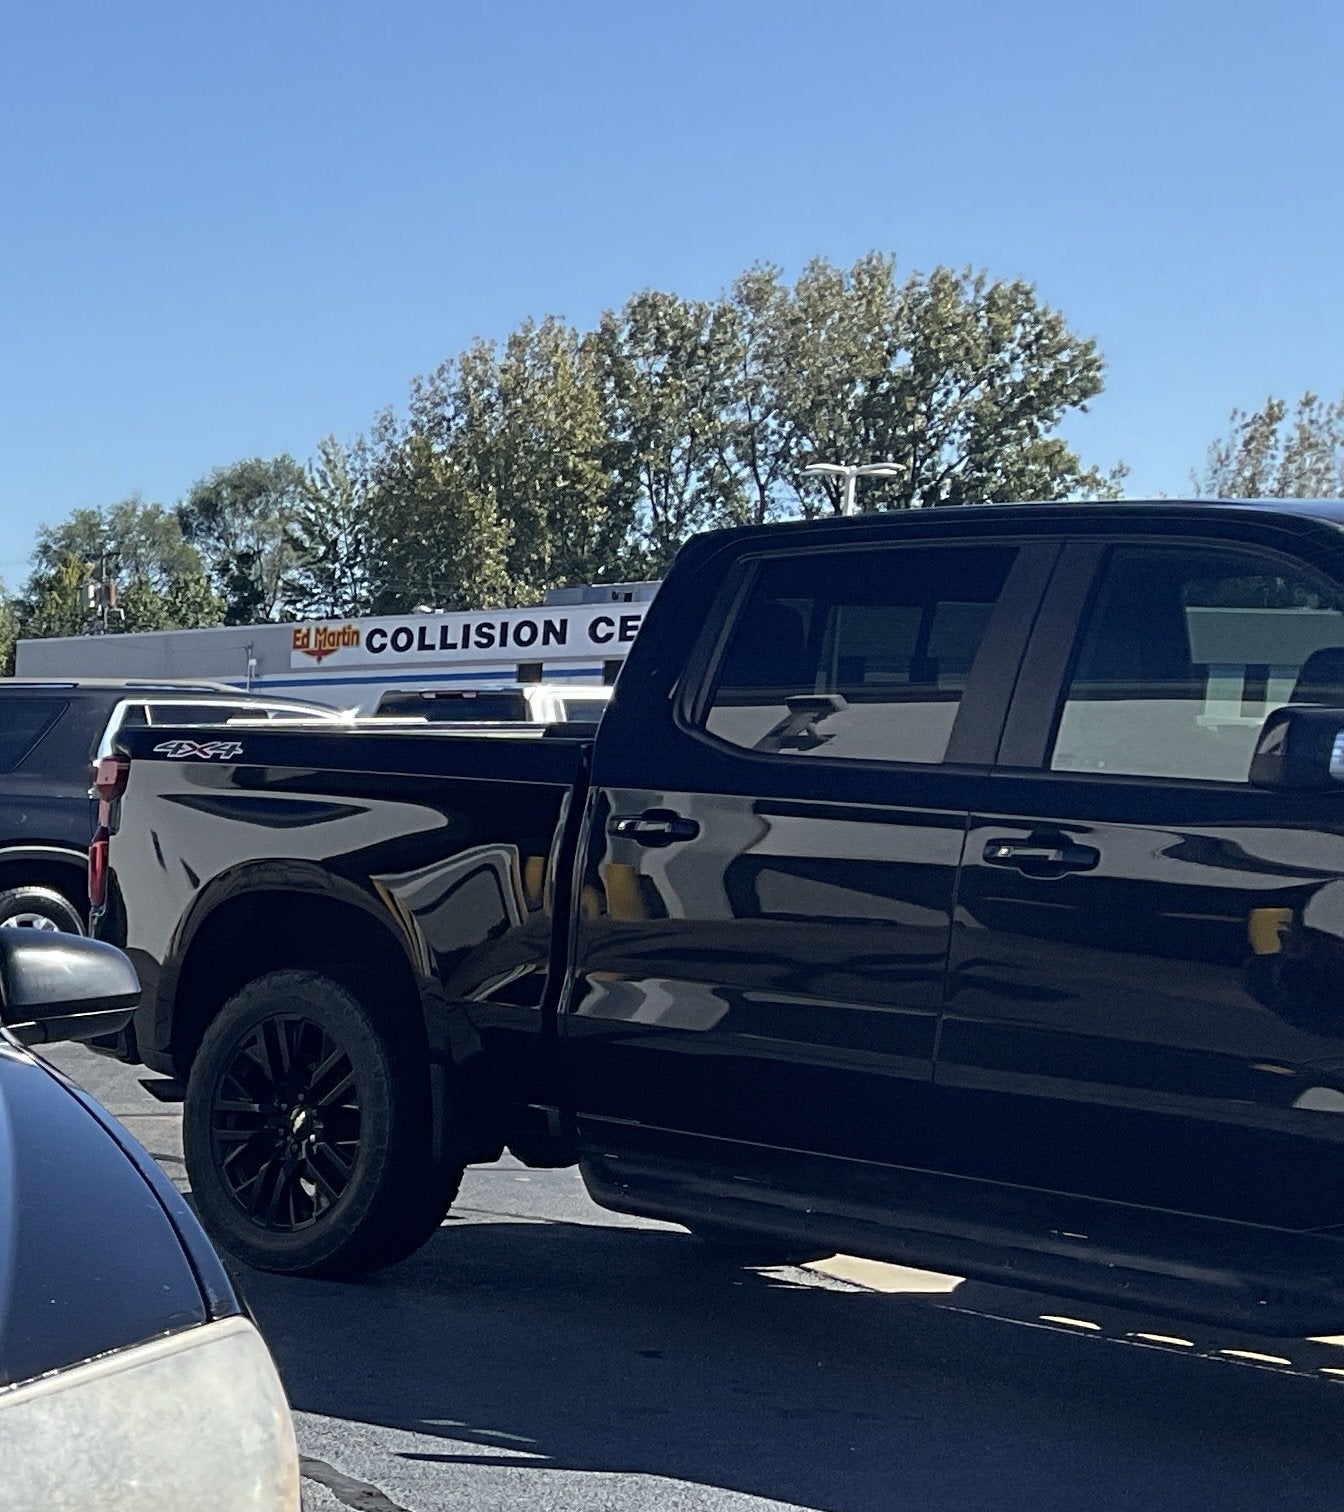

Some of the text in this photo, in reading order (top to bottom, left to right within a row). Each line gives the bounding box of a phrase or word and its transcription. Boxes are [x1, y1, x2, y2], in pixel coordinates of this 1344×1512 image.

[292, 627, 310, 649] Ed
[315, 624, 360, 650] Martin
[366, 618, 568, 653] COLLISION
